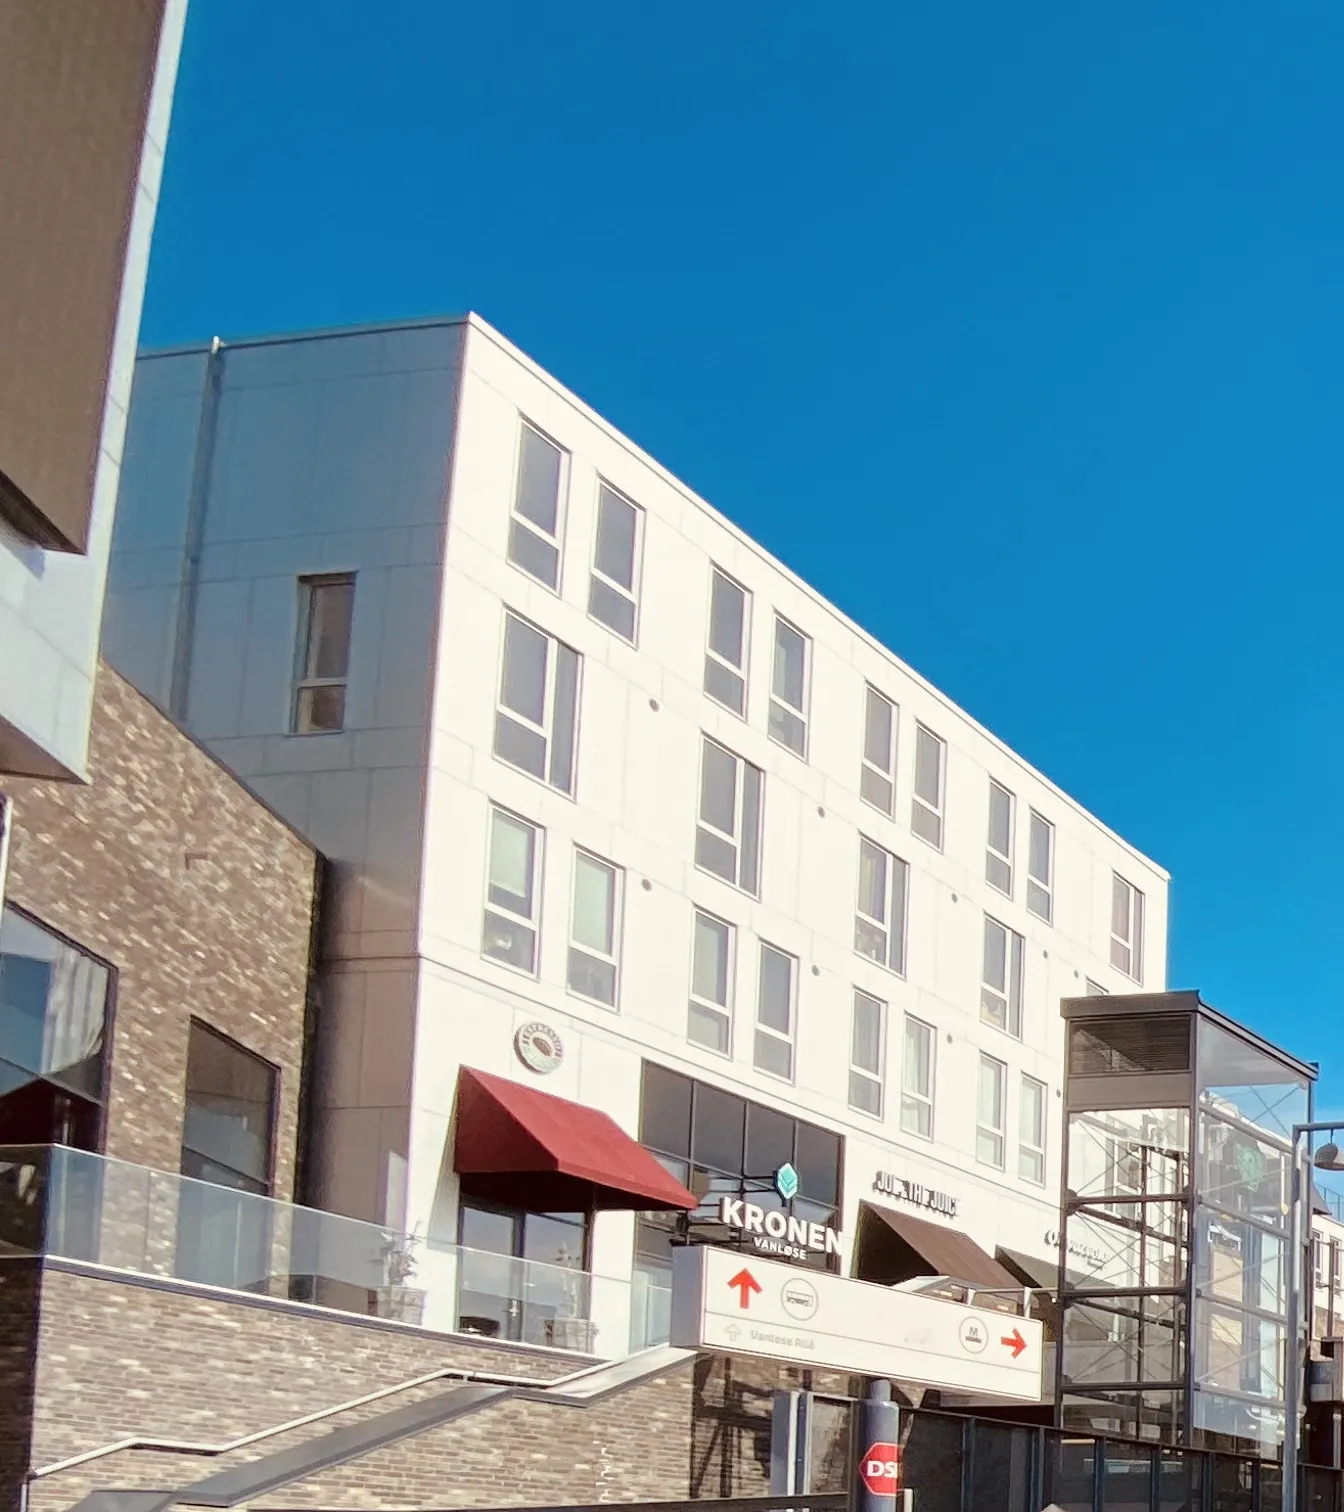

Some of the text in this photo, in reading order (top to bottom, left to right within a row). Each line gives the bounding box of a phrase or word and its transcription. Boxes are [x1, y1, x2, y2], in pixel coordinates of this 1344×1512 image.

[721, 1196, 844, 1257] KRONEN
[753, 1236, 808, 1261] VANLØSE
[867, 1460, 898, 1479] DS
